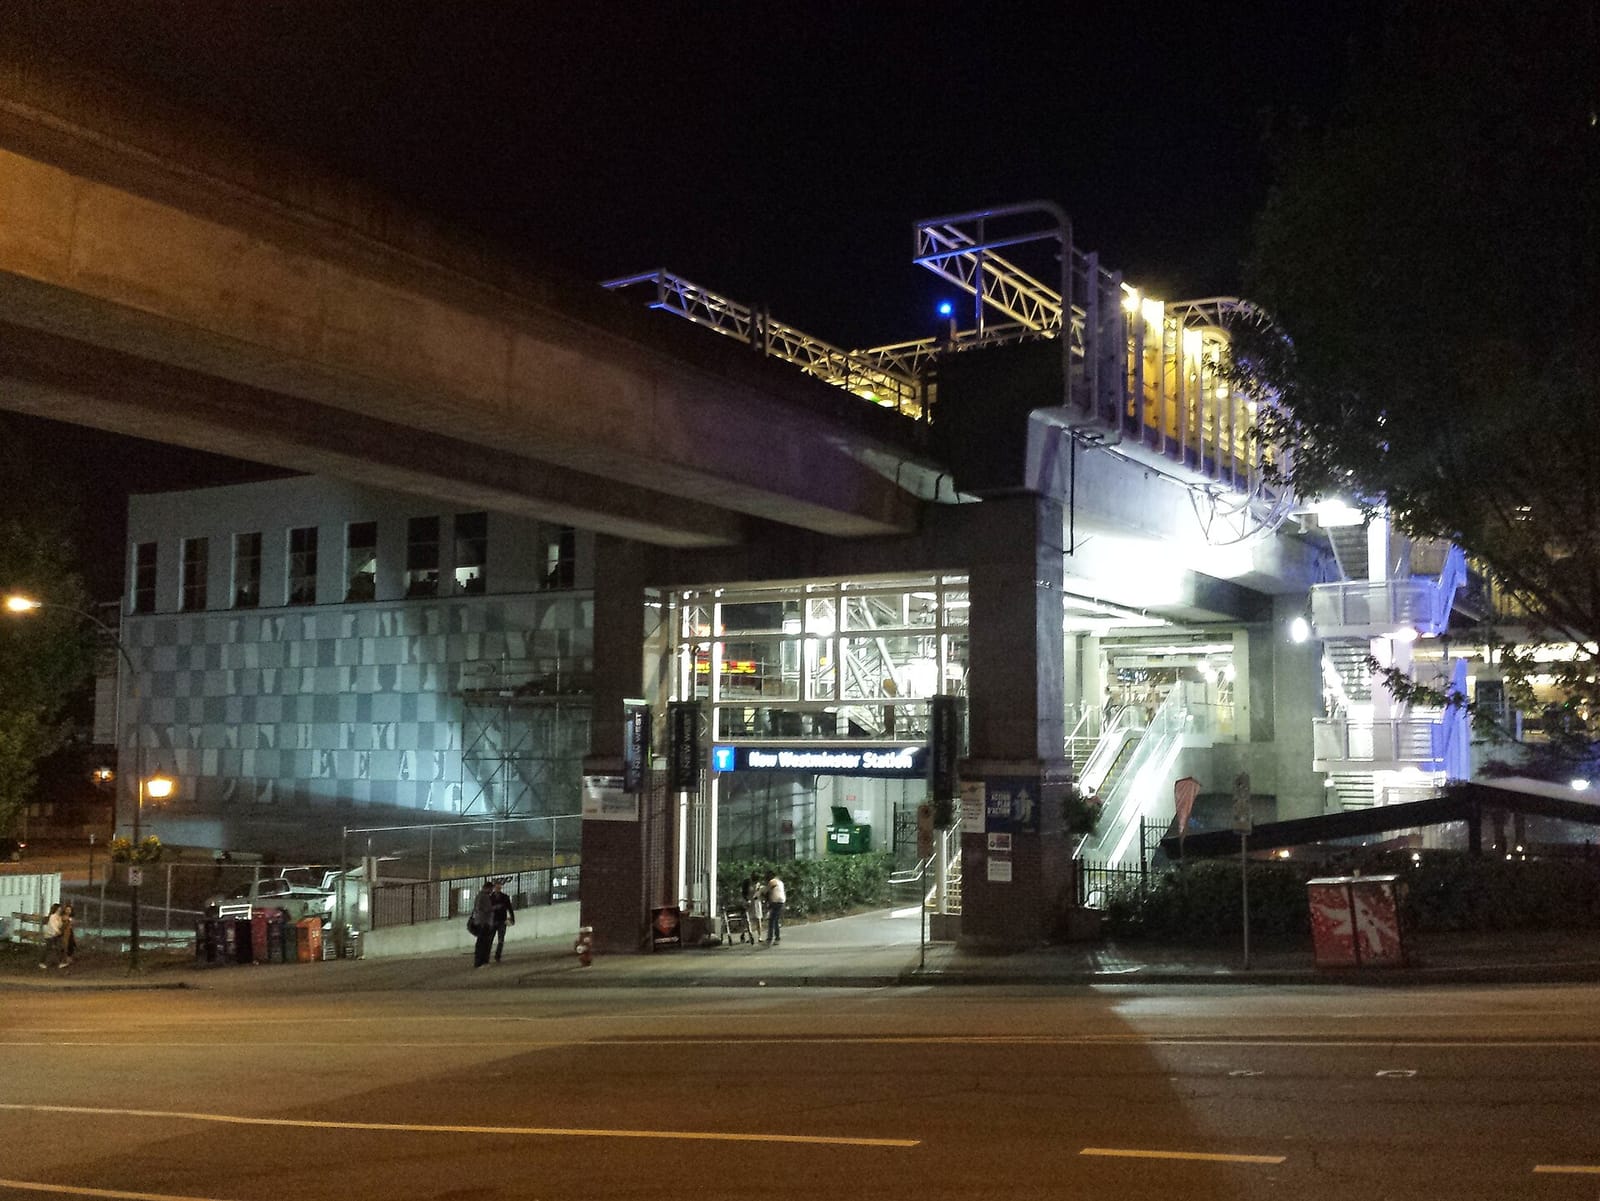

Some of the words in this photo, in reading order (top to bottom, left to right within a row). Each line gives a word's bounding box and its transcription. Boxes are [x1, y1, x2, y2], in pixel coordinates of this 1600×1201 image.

[749, 751, 778, 768] New
[778, 751, 861, 768] Westminster
[862, 751, 913, 769] Station
